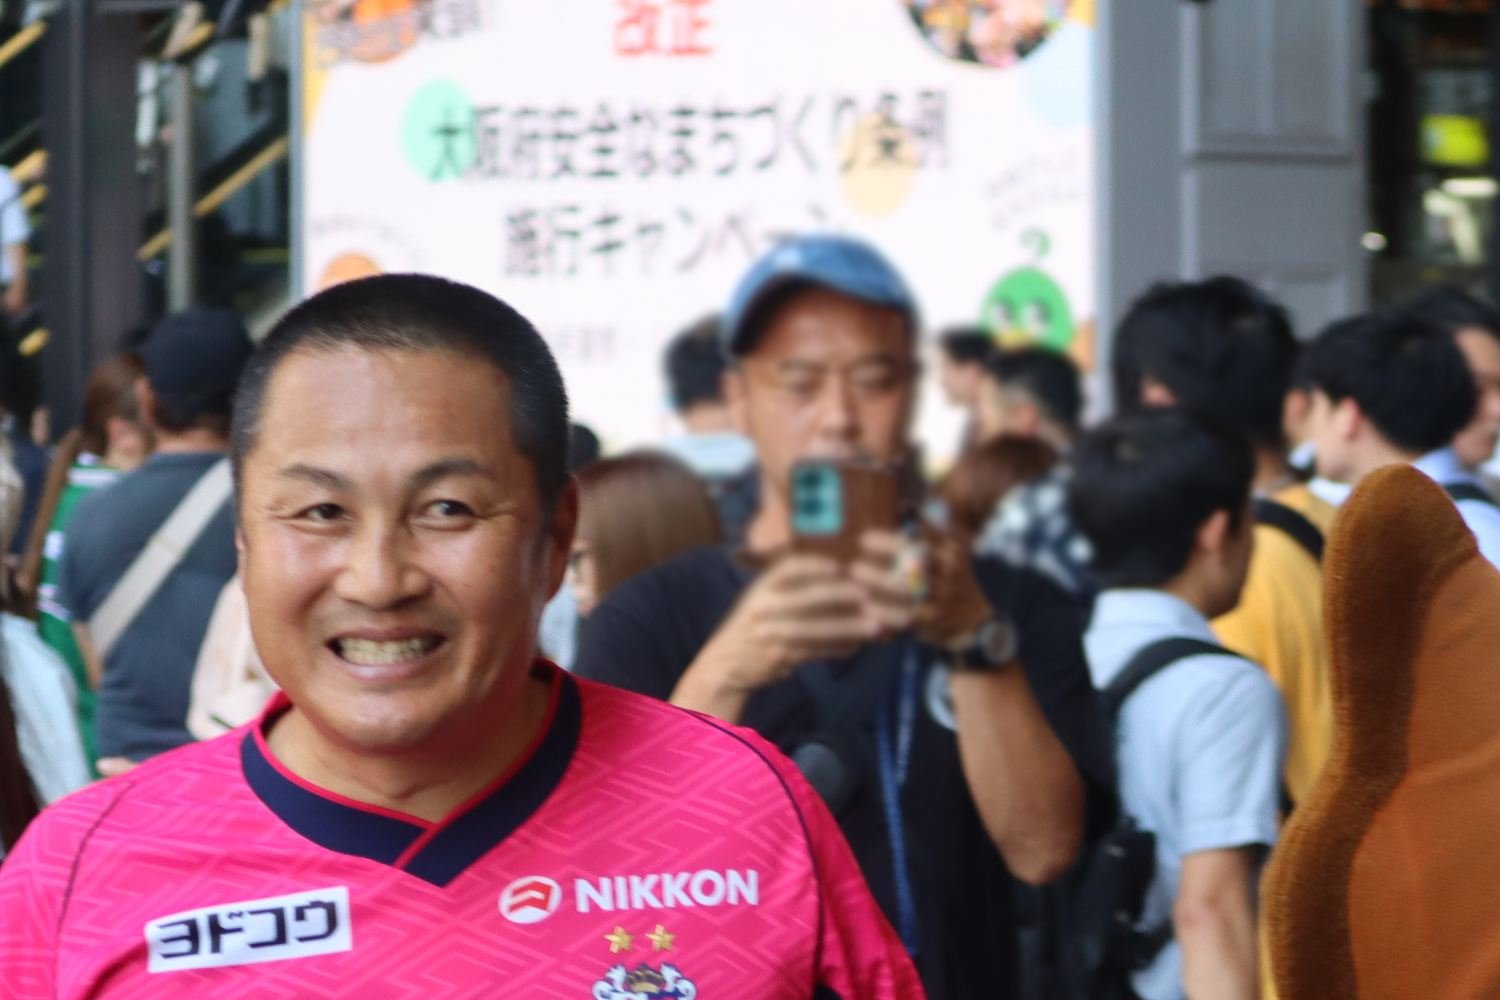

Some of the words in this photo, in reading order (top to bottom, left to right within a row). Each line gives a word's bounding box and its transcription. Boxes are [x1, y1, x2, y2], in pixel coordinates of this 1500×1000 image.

[574, 868, 760, 914] NIKKON
[157, 899, 340, 960] ヨドコウ
